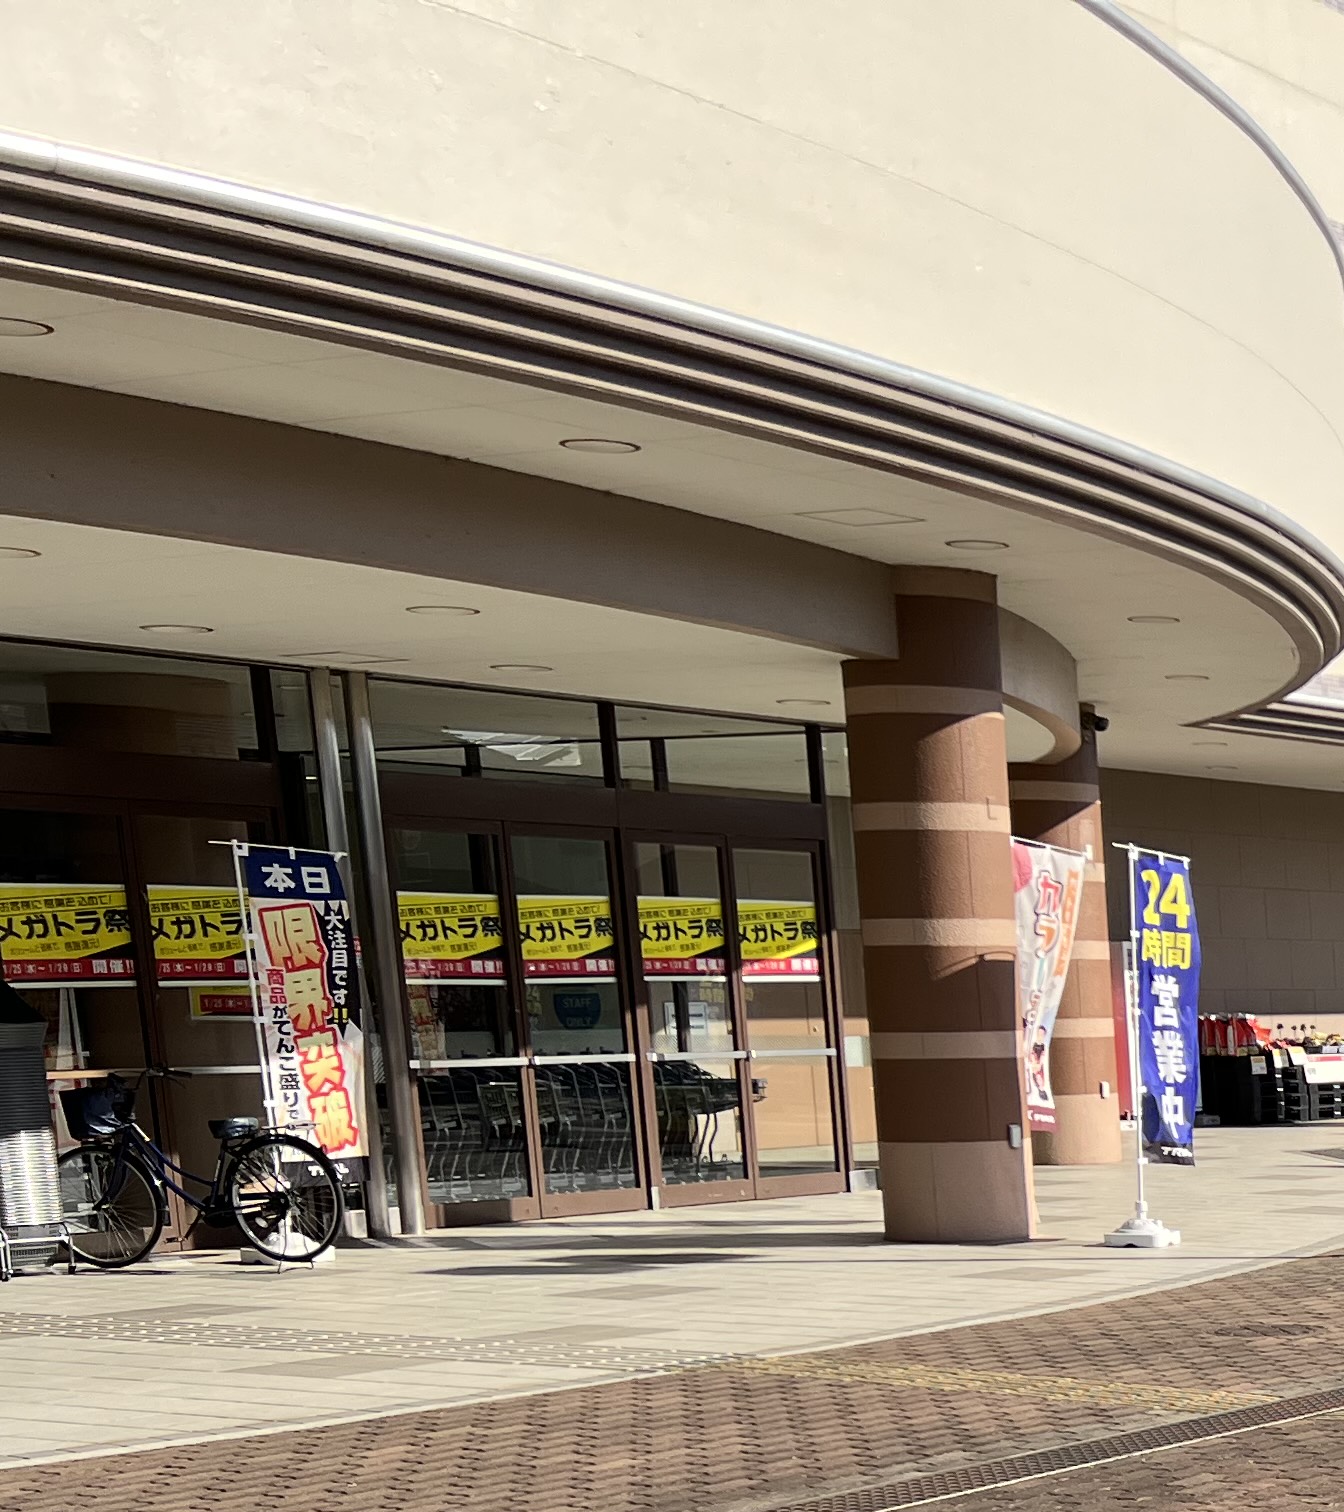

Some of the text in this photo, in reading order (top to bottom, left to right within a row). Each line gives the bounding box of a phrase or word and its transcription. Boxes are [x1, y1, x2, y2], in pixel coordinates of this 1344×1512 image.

[261, 863, 331, 893] 本日
[1141, 869, 1190, 929] 24
[0, 909, 130, 942] メガトラ祭
[151, 911, 250, 940] メガトラ
[400, 916, 503, 943] メガトラ祭
[520, 917, 614, 943] メガトラ祭
[639, 919, 724, 942] メガトラ祭
[739, 921, 818, 944] メガトラ祭
[1141, 928, 1192, 970] 時間
[258, 903, 359, 1154] 限界突破
[1149, 973, 1188, 1139] 営業中
